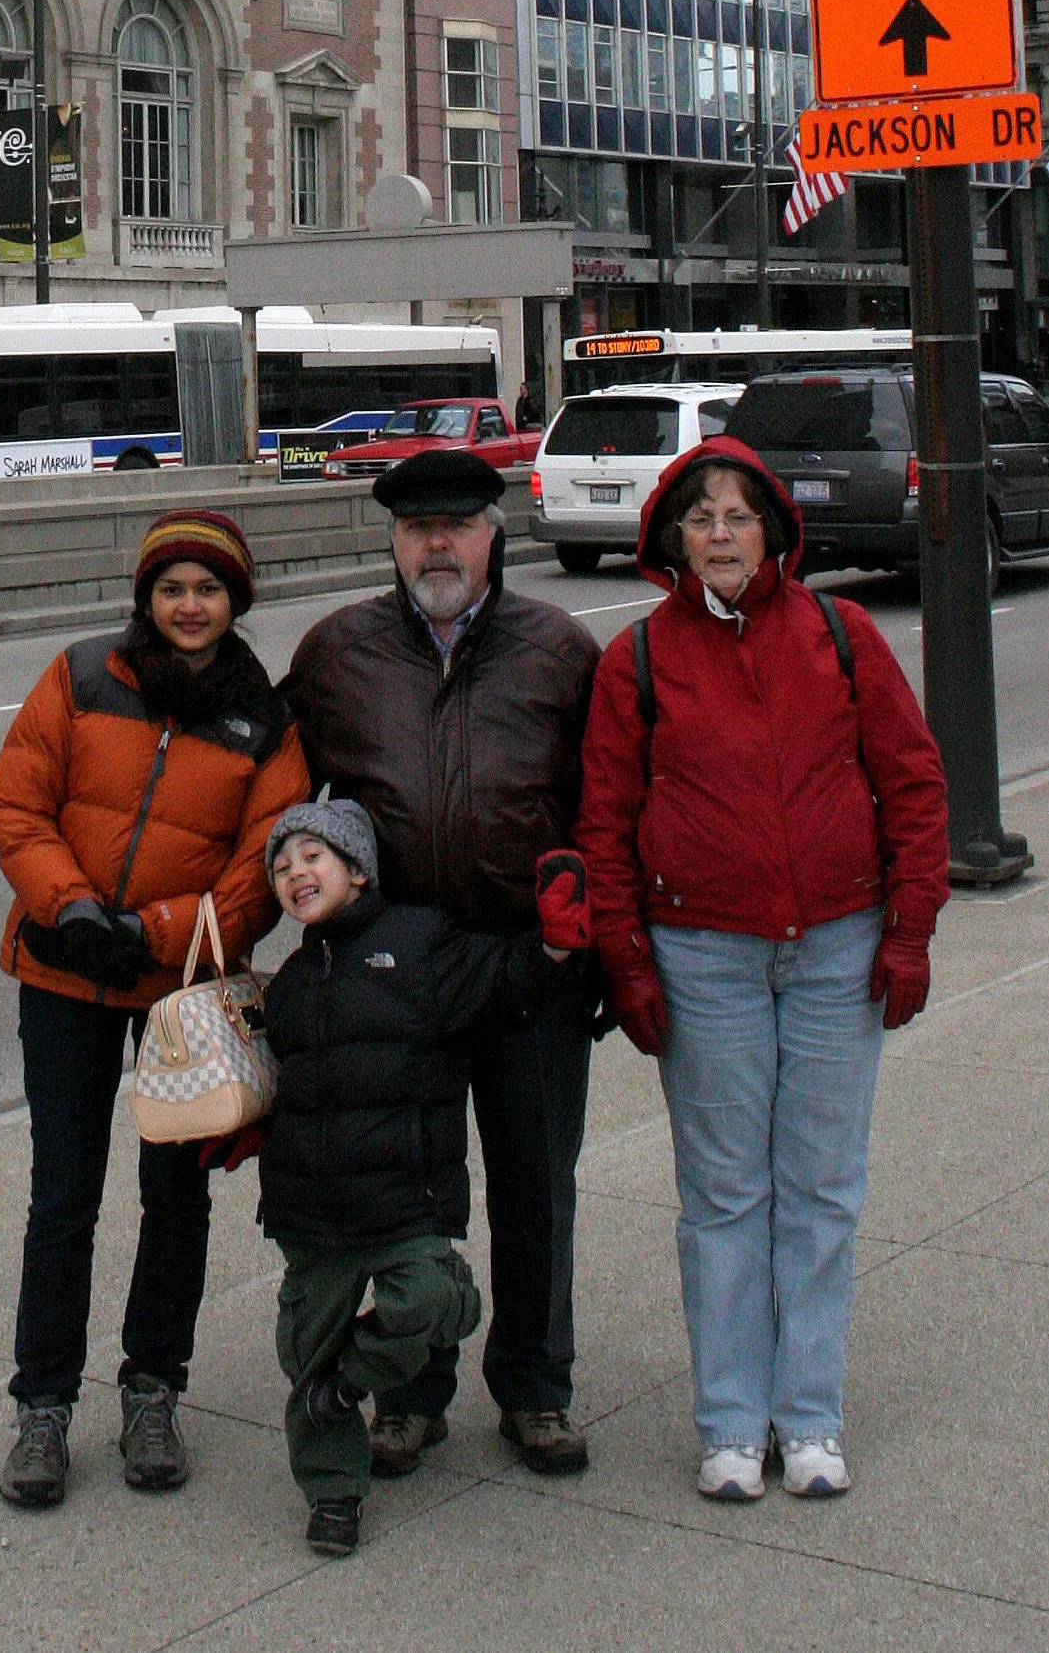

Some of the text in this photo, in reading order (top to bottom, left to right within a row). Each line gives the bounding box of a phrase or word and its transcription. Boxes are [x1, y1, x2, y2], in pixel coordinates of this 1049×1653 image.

[805, 107, 1036, 160] JACKSON DR
[586, 342, 596, 356] 14
[597, 342, 606, 355] TO
[4, 456, 37, 478] SARAH
[40, 454, 88, 474] MARSHALL
